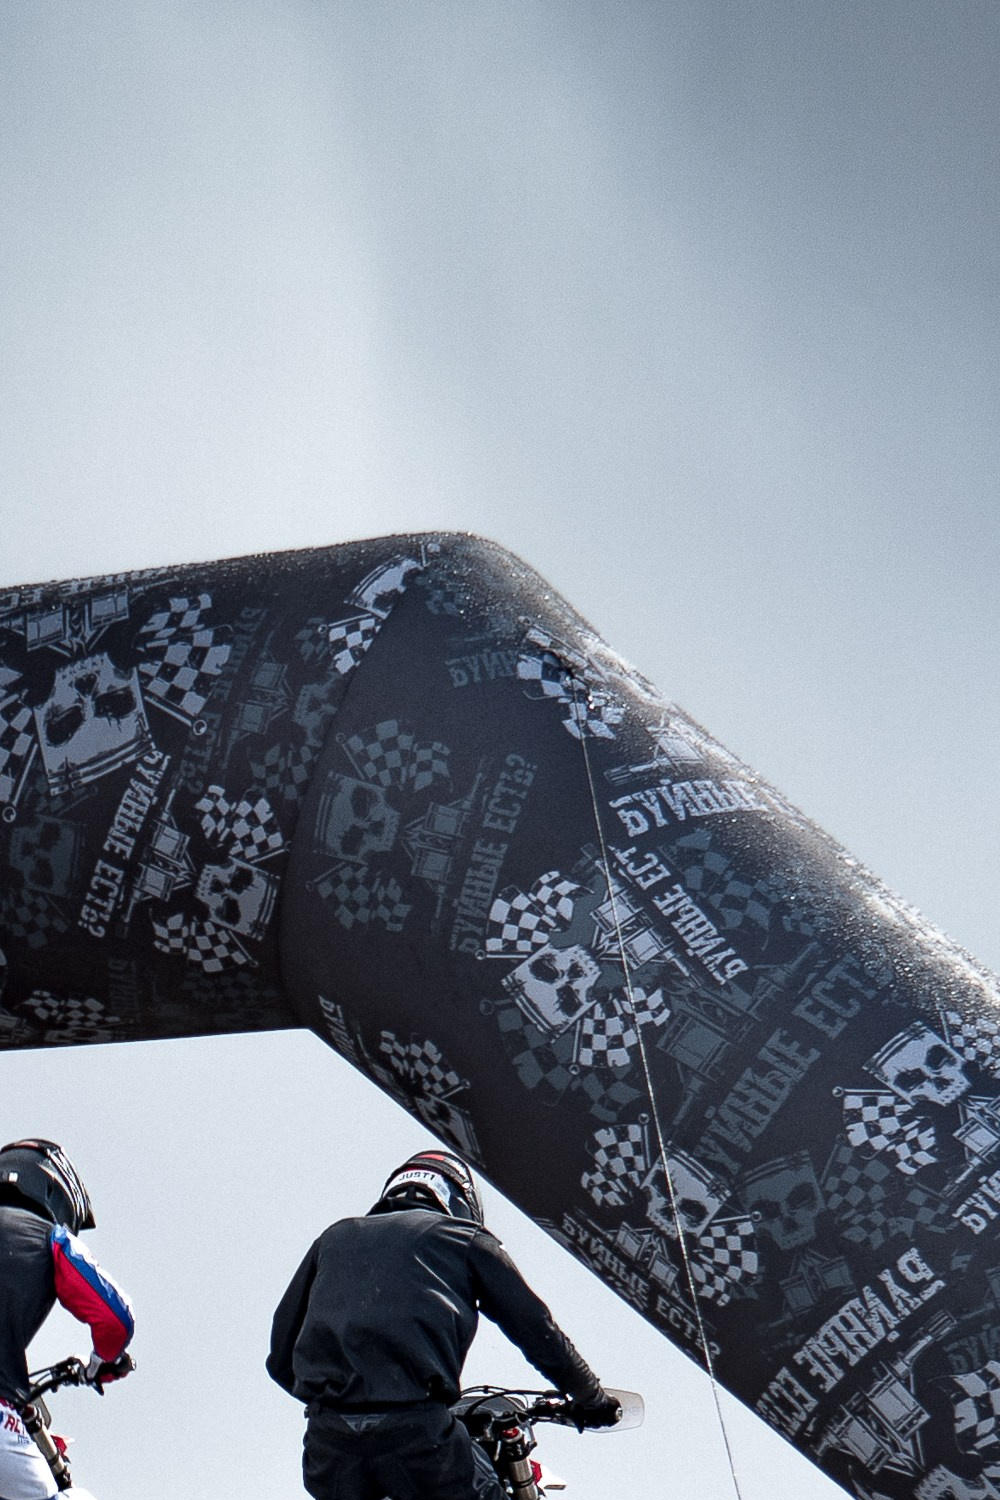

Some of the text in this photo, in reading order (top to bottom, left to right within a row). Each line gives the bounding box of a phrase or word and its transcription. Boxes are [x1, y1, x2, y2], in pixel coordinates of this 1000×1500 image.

[606, 844, 751, 986] БУЙНЫЕ ЕСТ
[692, 1027, 822, 1176] УЙНЫЕ
[792, 1246, 947, 1395] БУЙНЫЕ
